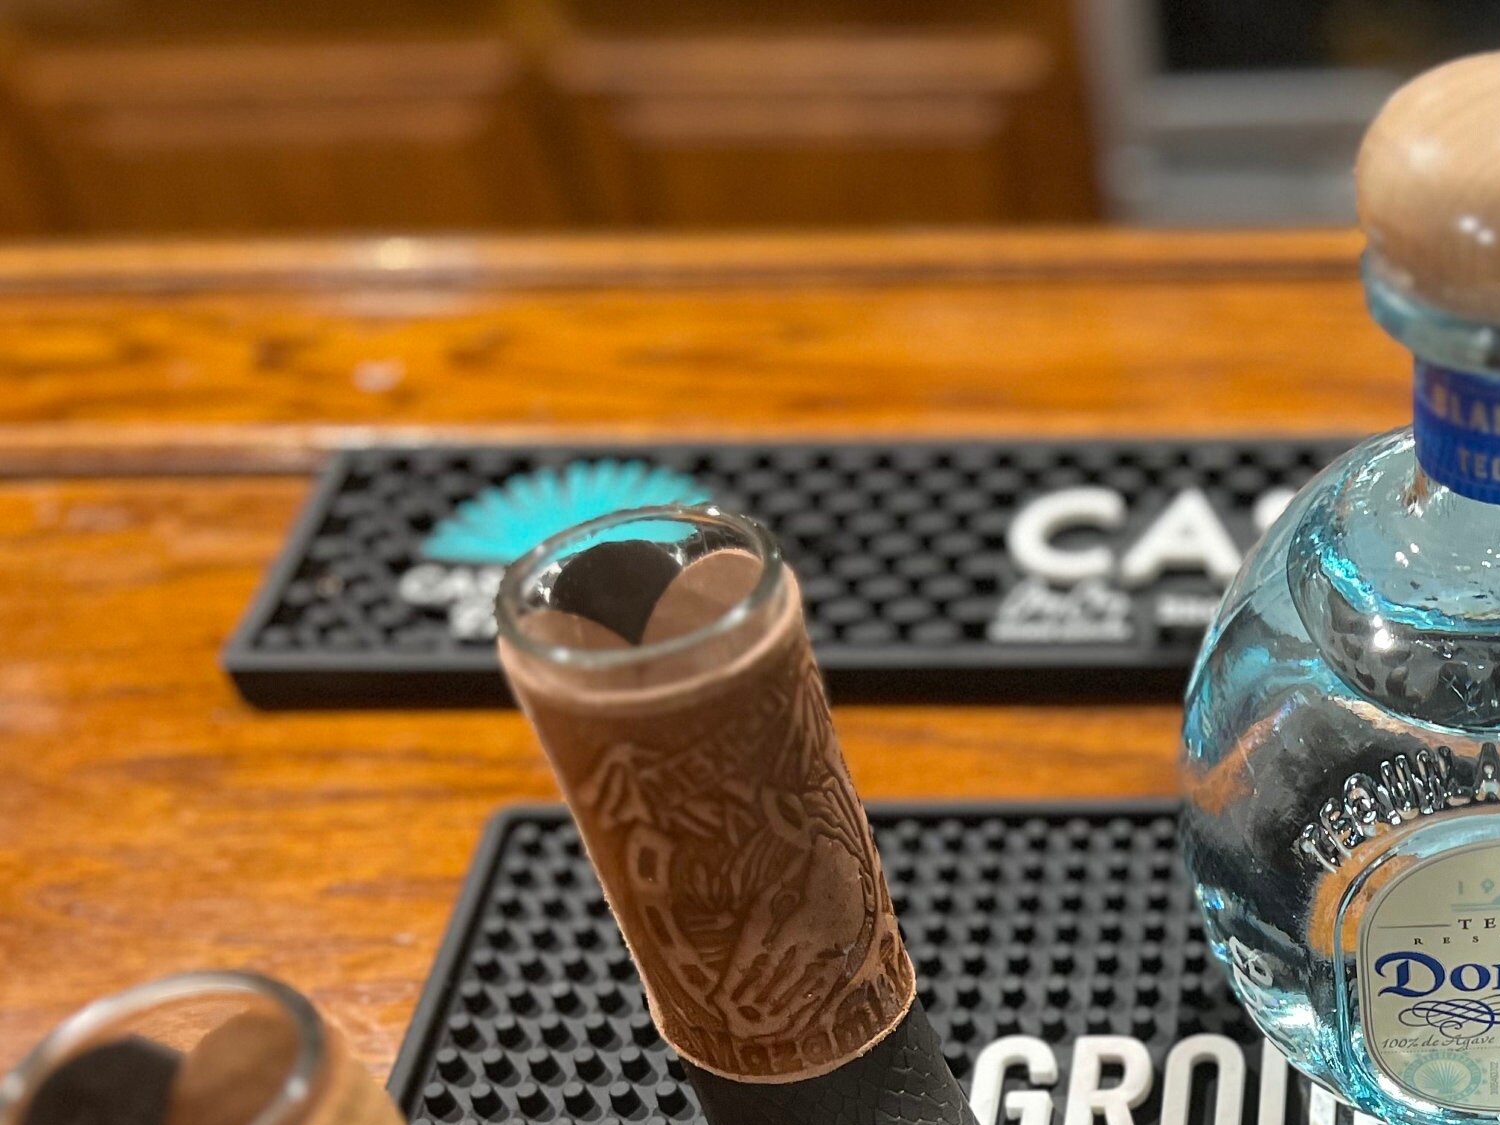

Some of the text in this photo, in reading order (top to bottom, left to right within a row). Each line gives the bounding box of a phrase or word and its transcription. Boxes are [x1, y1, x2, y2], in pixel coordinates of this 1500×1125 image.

[1381, 1034, 1496, 1051] 100% de Agave
